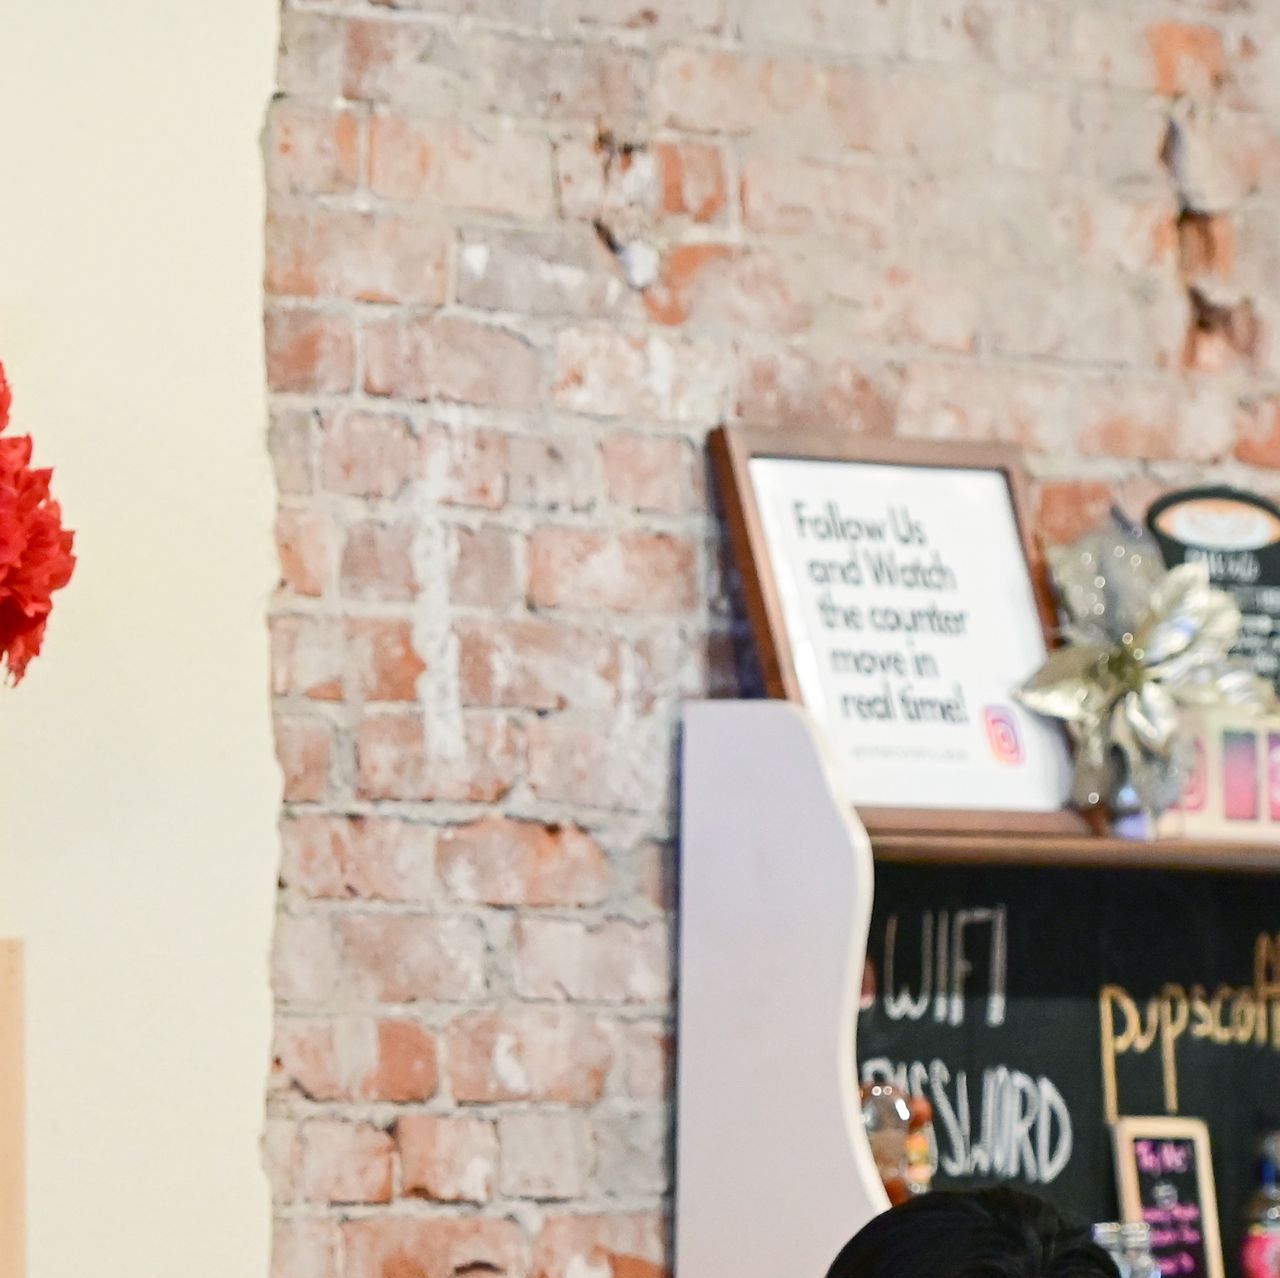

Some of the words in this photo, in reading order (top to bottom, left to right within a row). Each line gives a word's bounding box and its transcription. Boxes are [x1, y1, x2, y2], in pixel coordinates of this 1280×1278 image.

[794, 501, 887, 542] Follow
[888, 504, 926, 546] Us
[809, 546, 863, 586] and
[864, 548, 958, 591] Watch
[818, 594, 862, 630] the
[870, 602, 968, 637] counter
[831, 649, 906, 677] move
[908, 636, 939, 679] in
[839, 682, 896, 721] real
[899, 682, 969, 726] time!
[883, 903, 1008, 1030] WIFI
